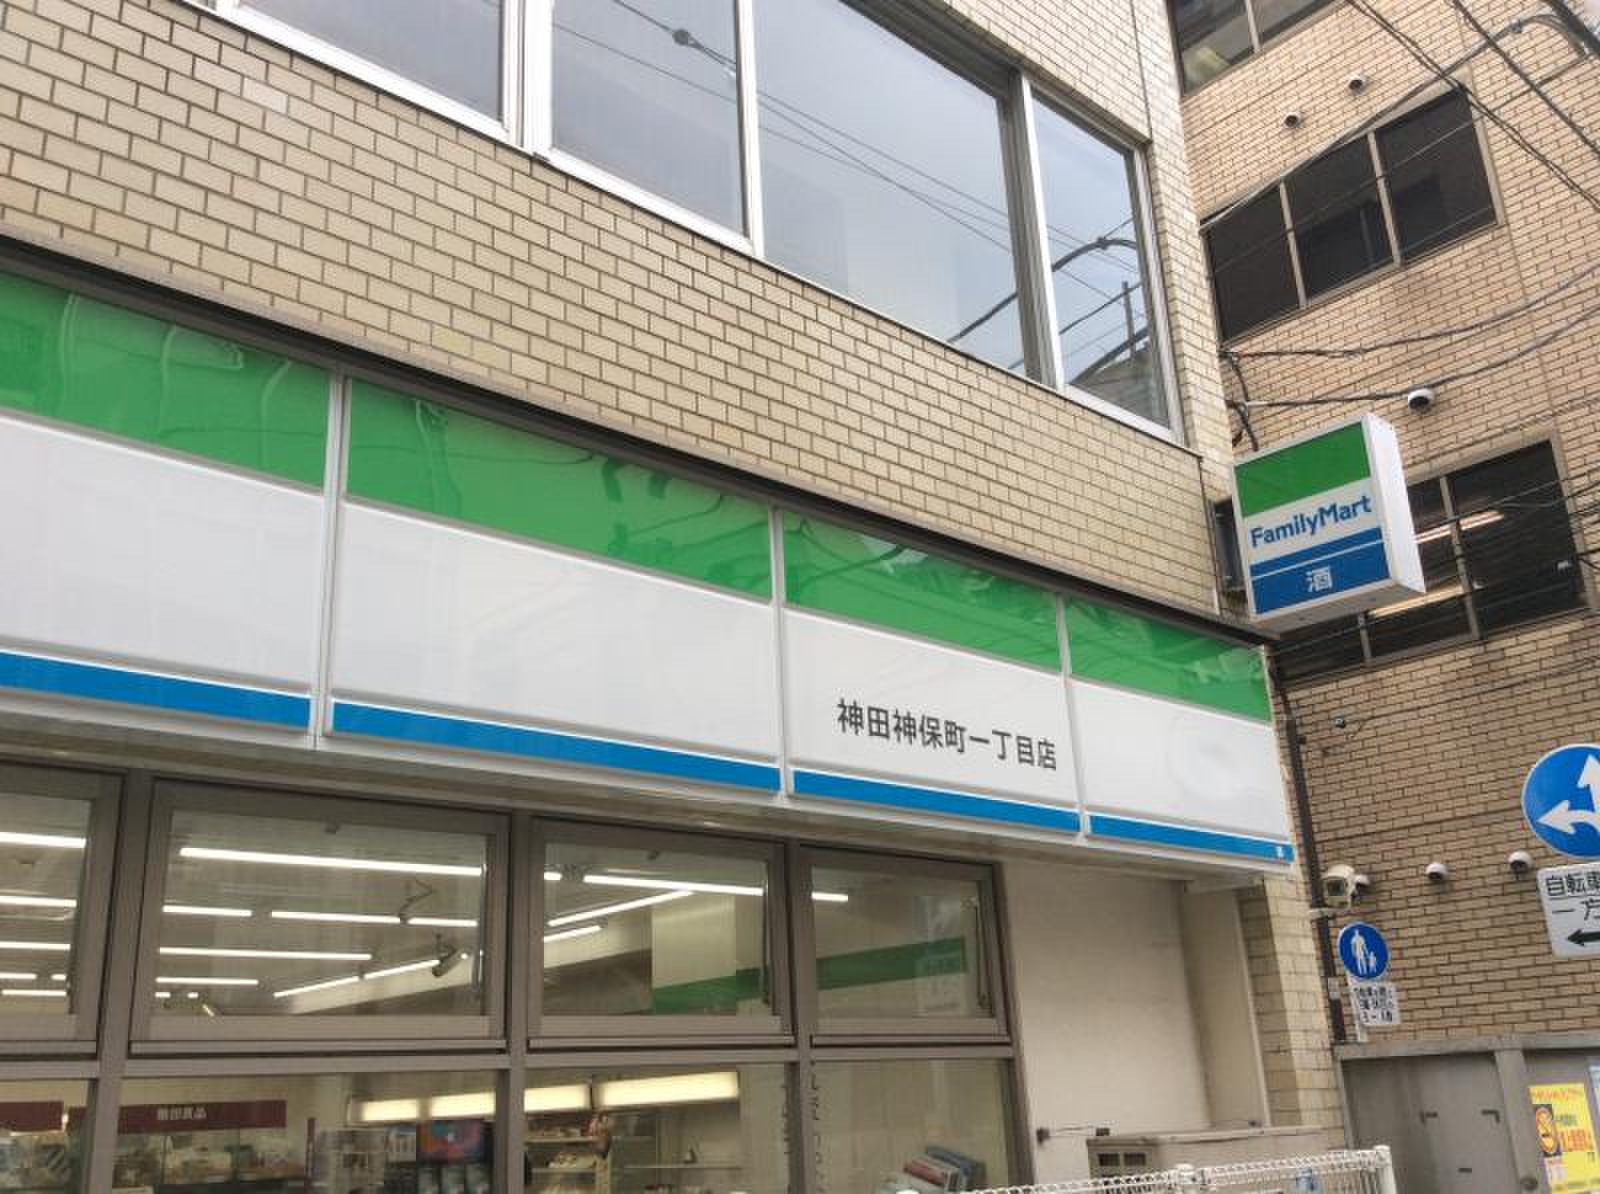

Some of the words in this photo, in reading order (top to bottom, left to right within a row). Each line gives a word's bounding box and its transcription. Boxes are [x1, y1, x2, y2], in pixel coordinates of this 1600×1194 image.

[1250, 495, 1372, 547] FamilyMart
[1305, 566, 1333, 592] 酒
[837, 698, 1057, 770] 神田神保町一丁目店
